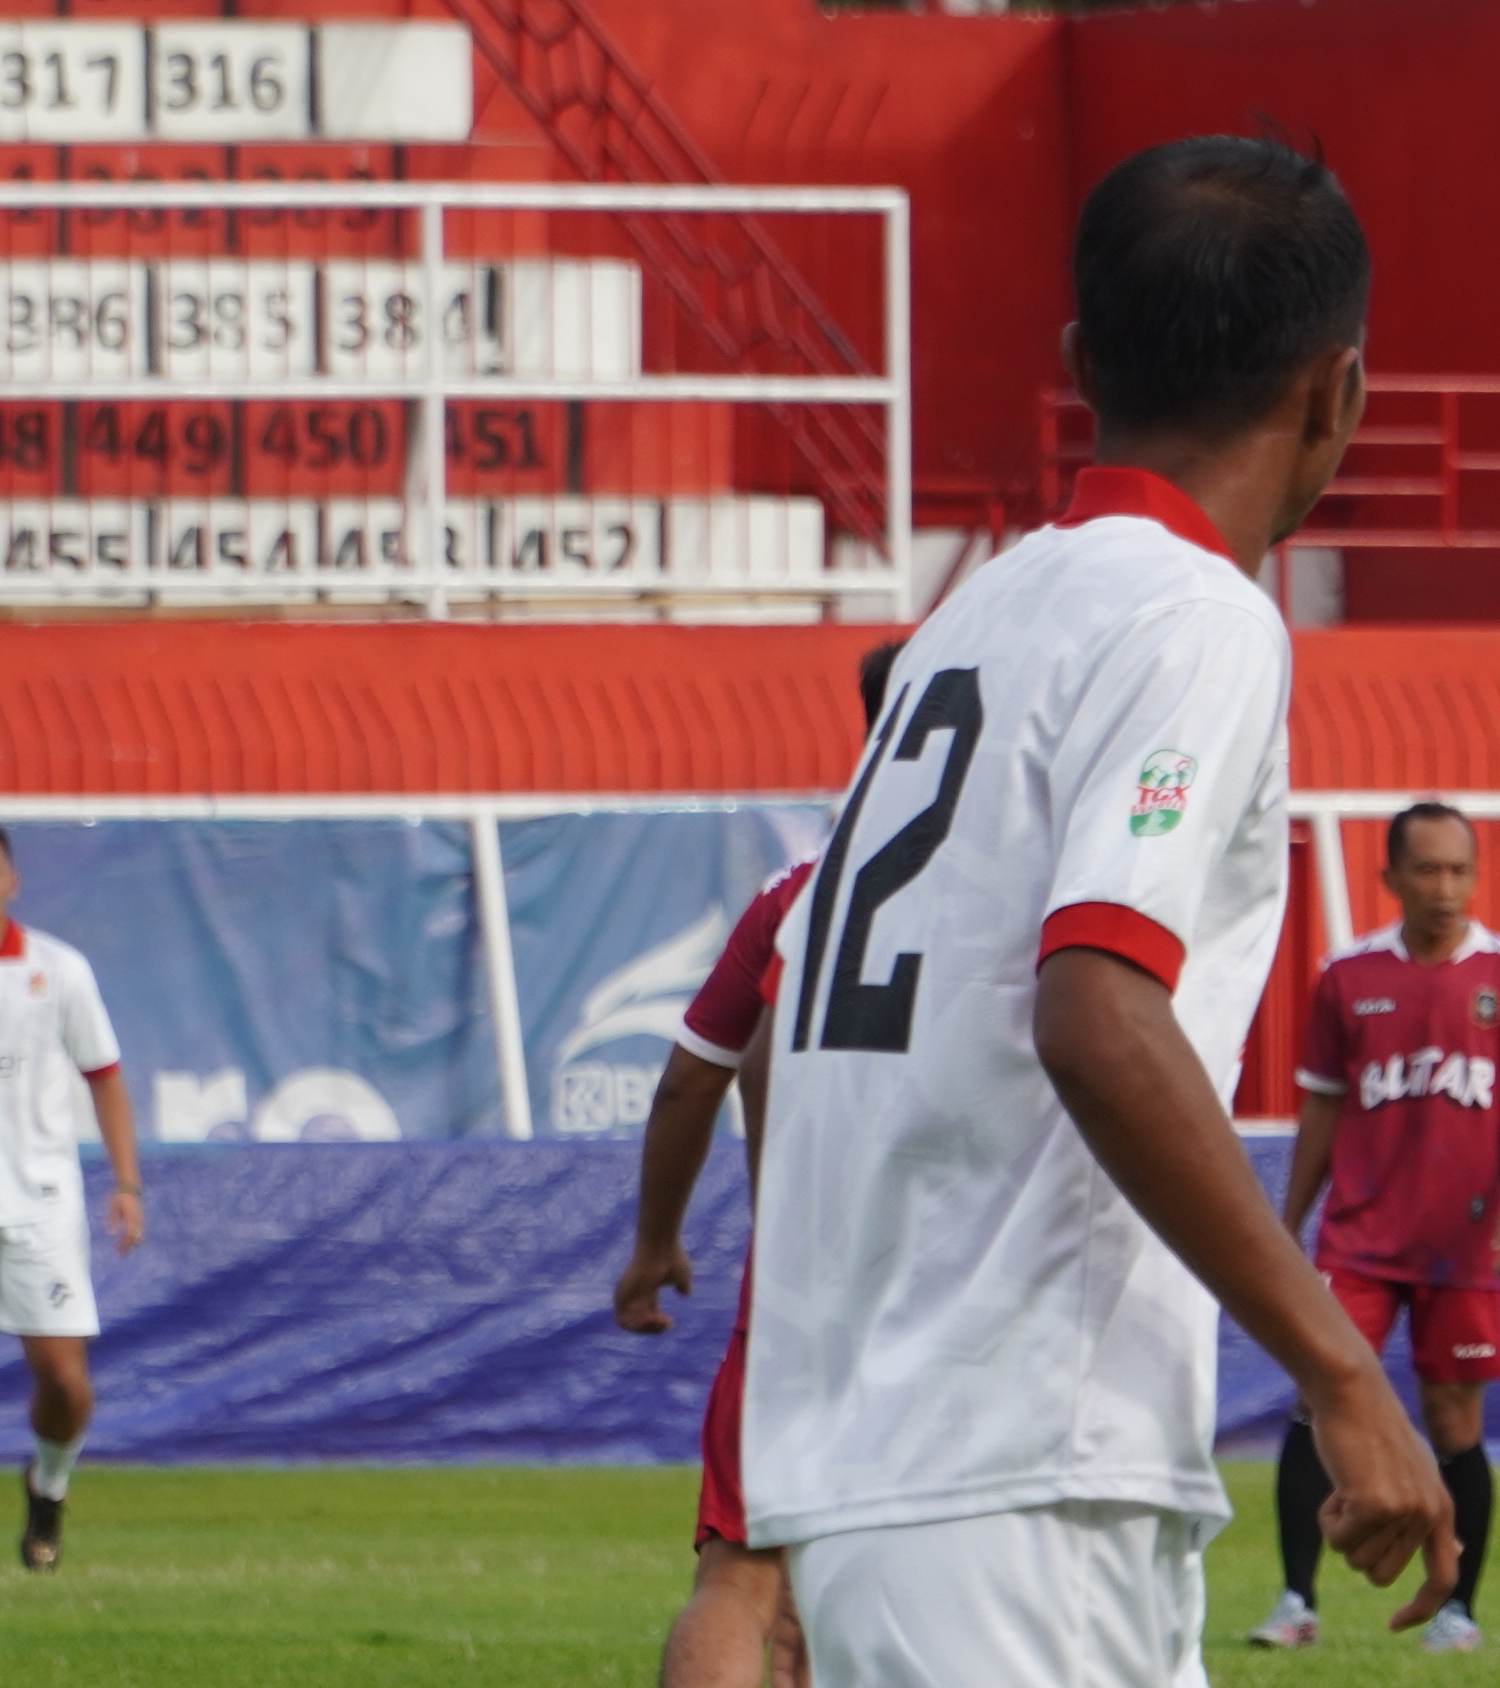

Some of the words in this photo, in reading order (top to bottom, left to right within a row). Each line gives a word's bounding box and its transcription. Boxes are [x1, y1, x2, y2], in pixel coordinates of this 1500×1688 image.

[1, 51, 122, 117] 317
[163, 51, 286, 114] 316
[7, 291, 132, 355] 386
[166, 291, 296, 354] 385
[86, 405, 229, 474] 449
[260, 407, 390, 470] 450
[791, 665, 985, 1054] 12
